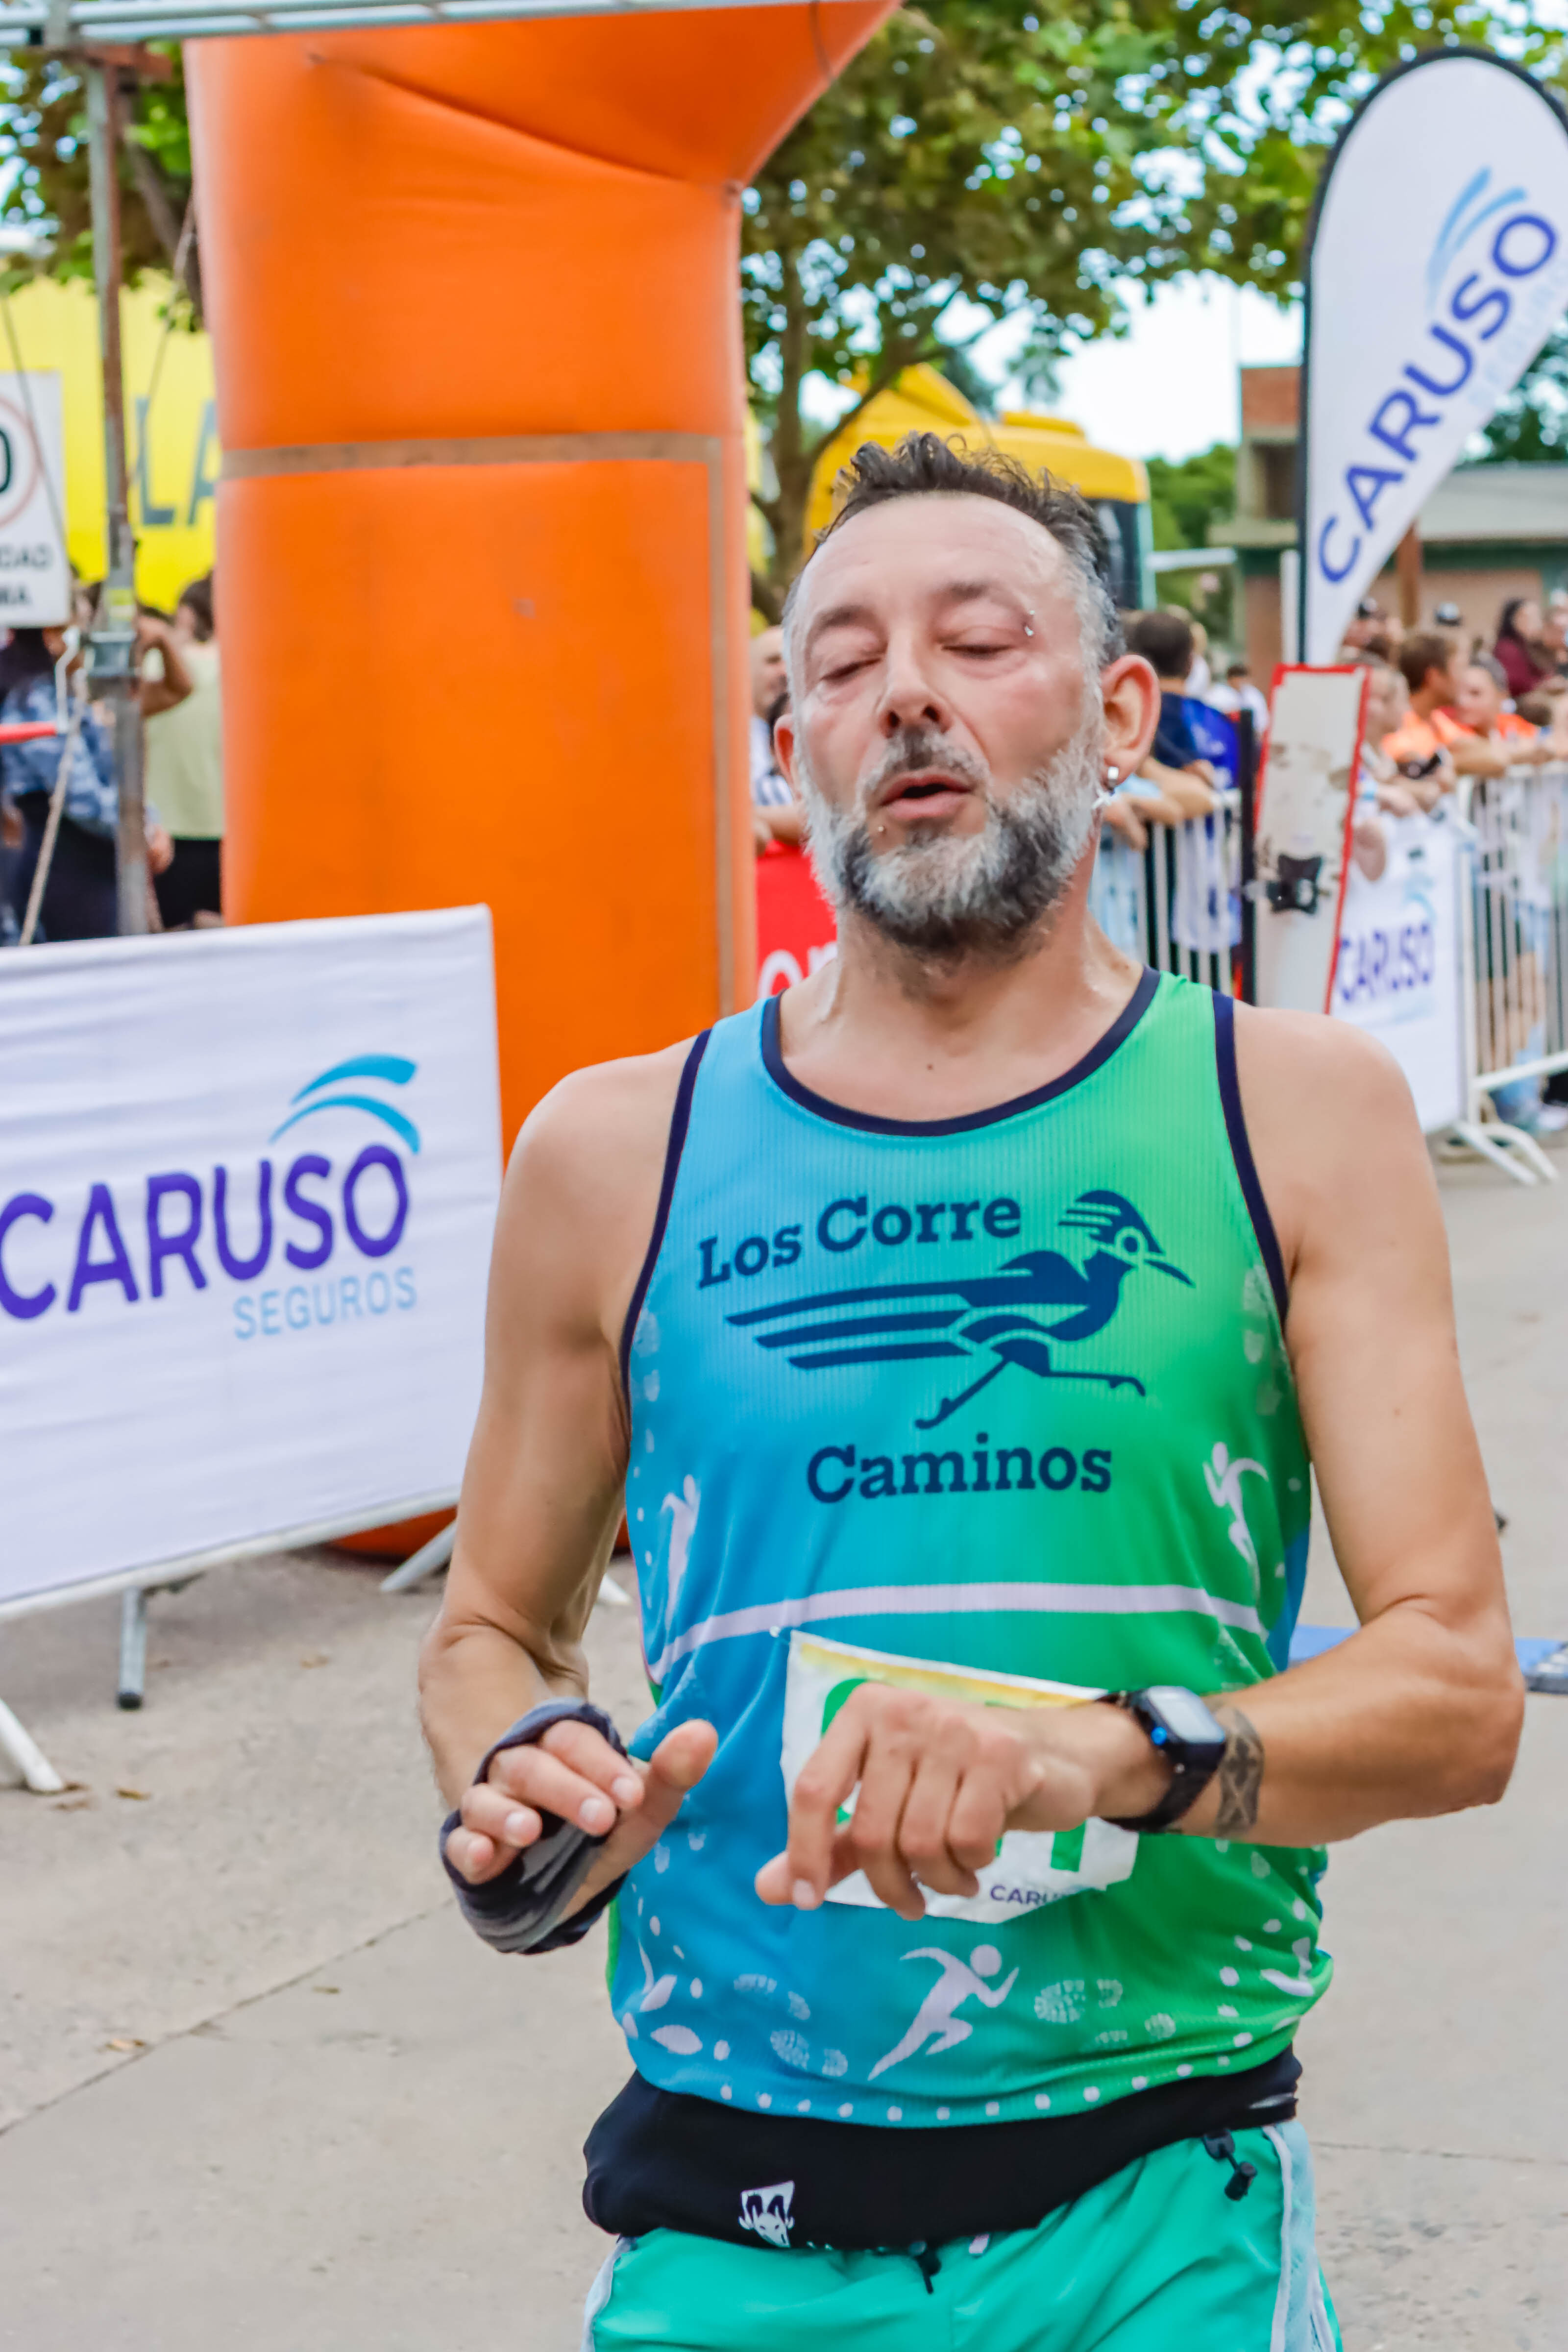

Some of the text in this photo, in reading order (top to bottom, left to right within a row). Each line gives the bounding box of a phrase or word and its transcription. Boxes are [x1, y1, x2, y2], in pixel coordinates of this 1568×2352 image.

[1319, 213, 1557, 584] CARUSO
[0, 1143, 409, 1320] CARUSO
[697, 1196, 1021, 1290] Los Corre
[233, 1267, 417, 1340] SEGUROS
[807, 1432, 1112, 1504] Caminos
